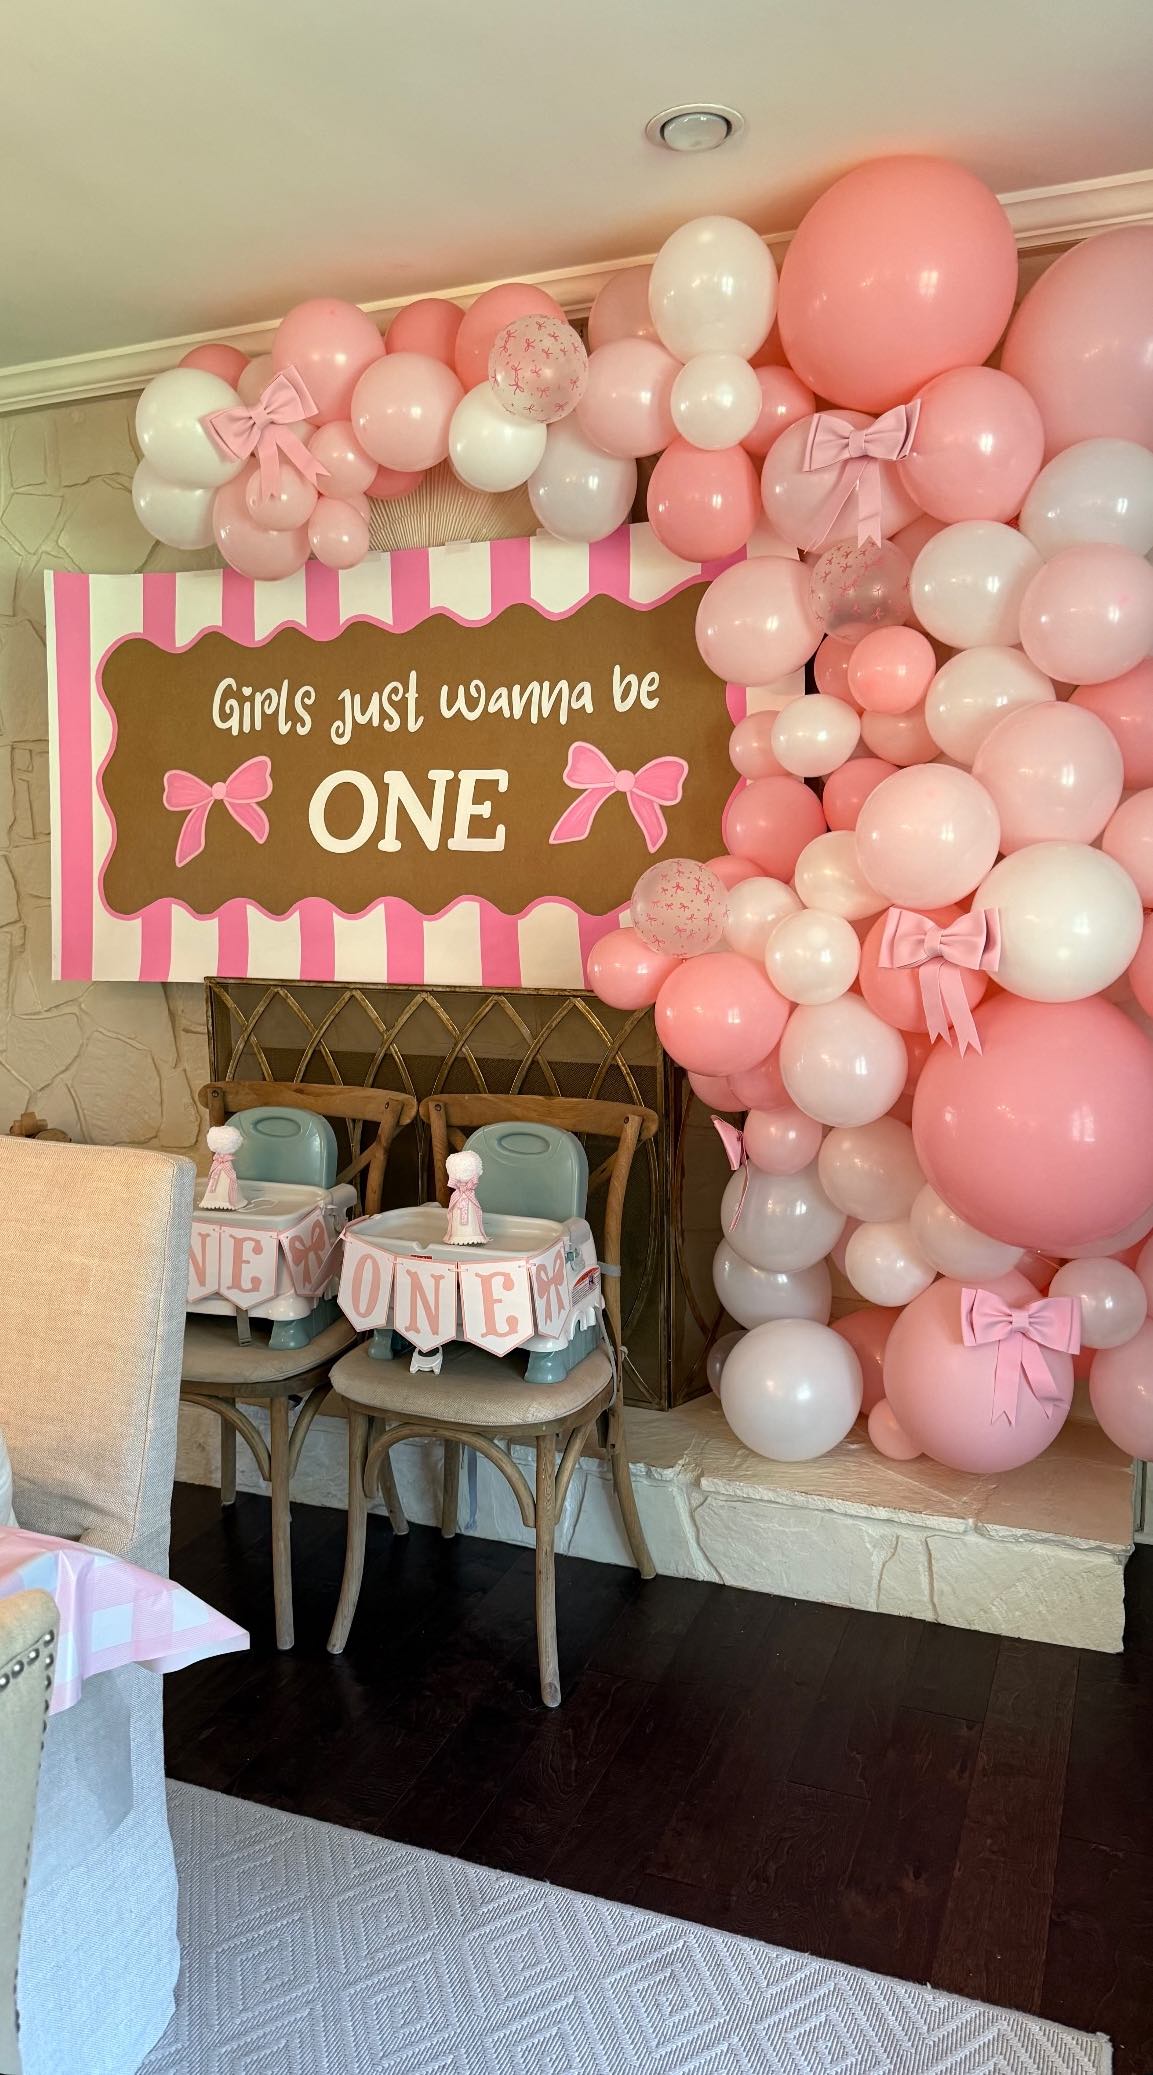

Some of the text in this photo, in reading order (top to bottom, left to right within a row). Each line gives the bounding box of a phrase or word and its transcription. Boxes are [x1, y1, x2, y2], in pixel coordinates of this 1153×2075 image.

[213, 665, 660, 745] Girls just wanna be
[309, 769, 508, 853] ONE
[188, 1232, 263, 1293] NE
[352, 1252, 518, 1337] ONE
